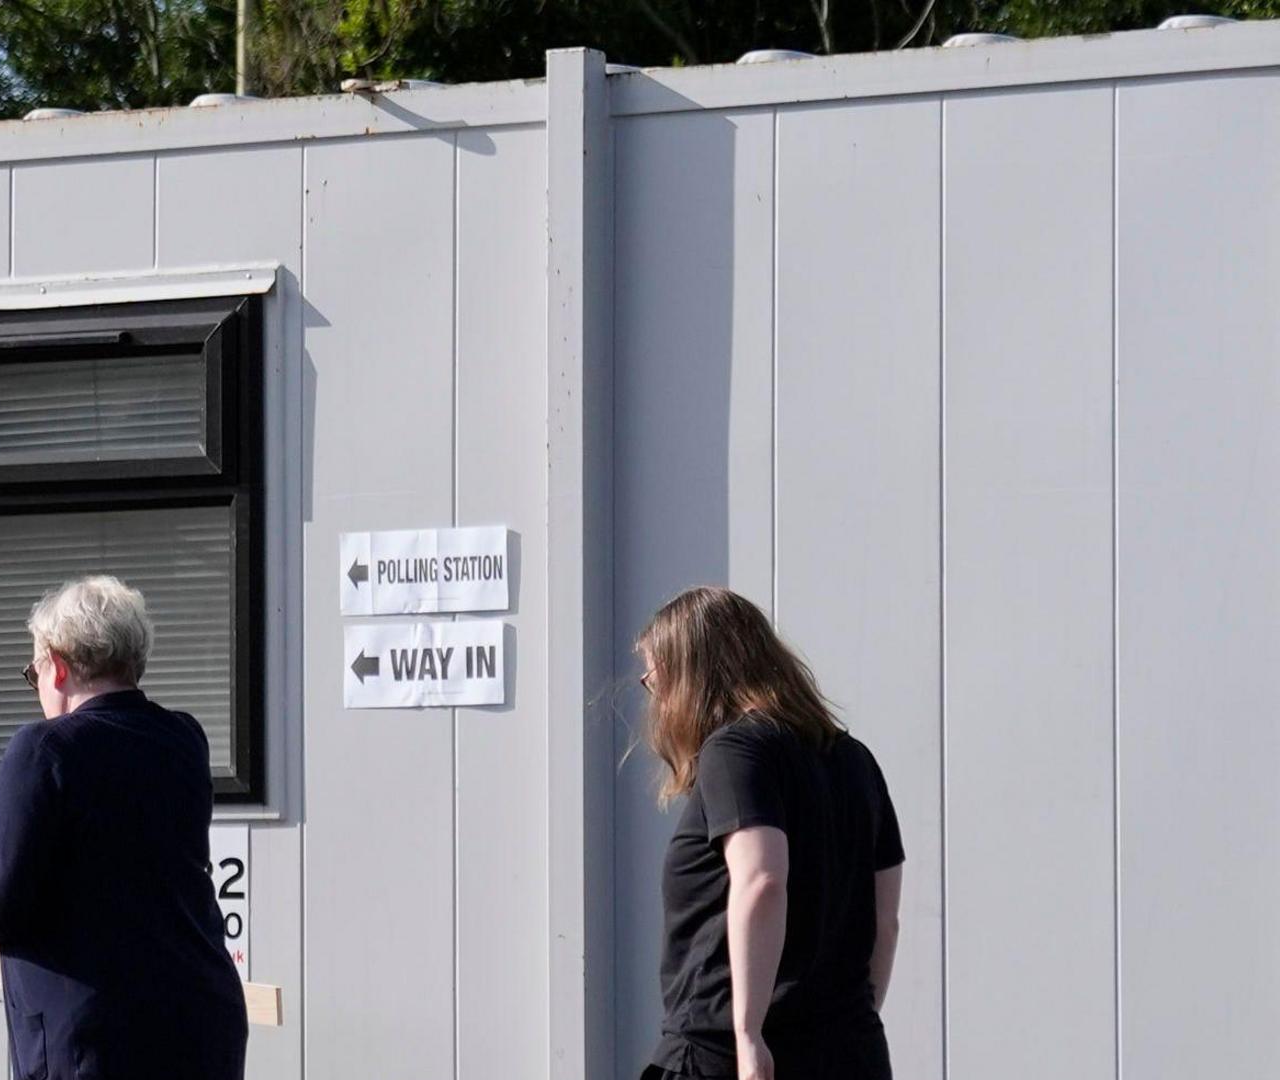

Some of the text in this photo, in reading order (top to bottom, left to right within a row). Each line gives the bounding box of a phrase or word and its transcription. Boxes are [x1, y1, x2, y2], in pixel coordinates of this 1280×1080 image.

[377, 555, 503, 584] POLLING STATION
[390, 646, 496, 682] WAY IN
